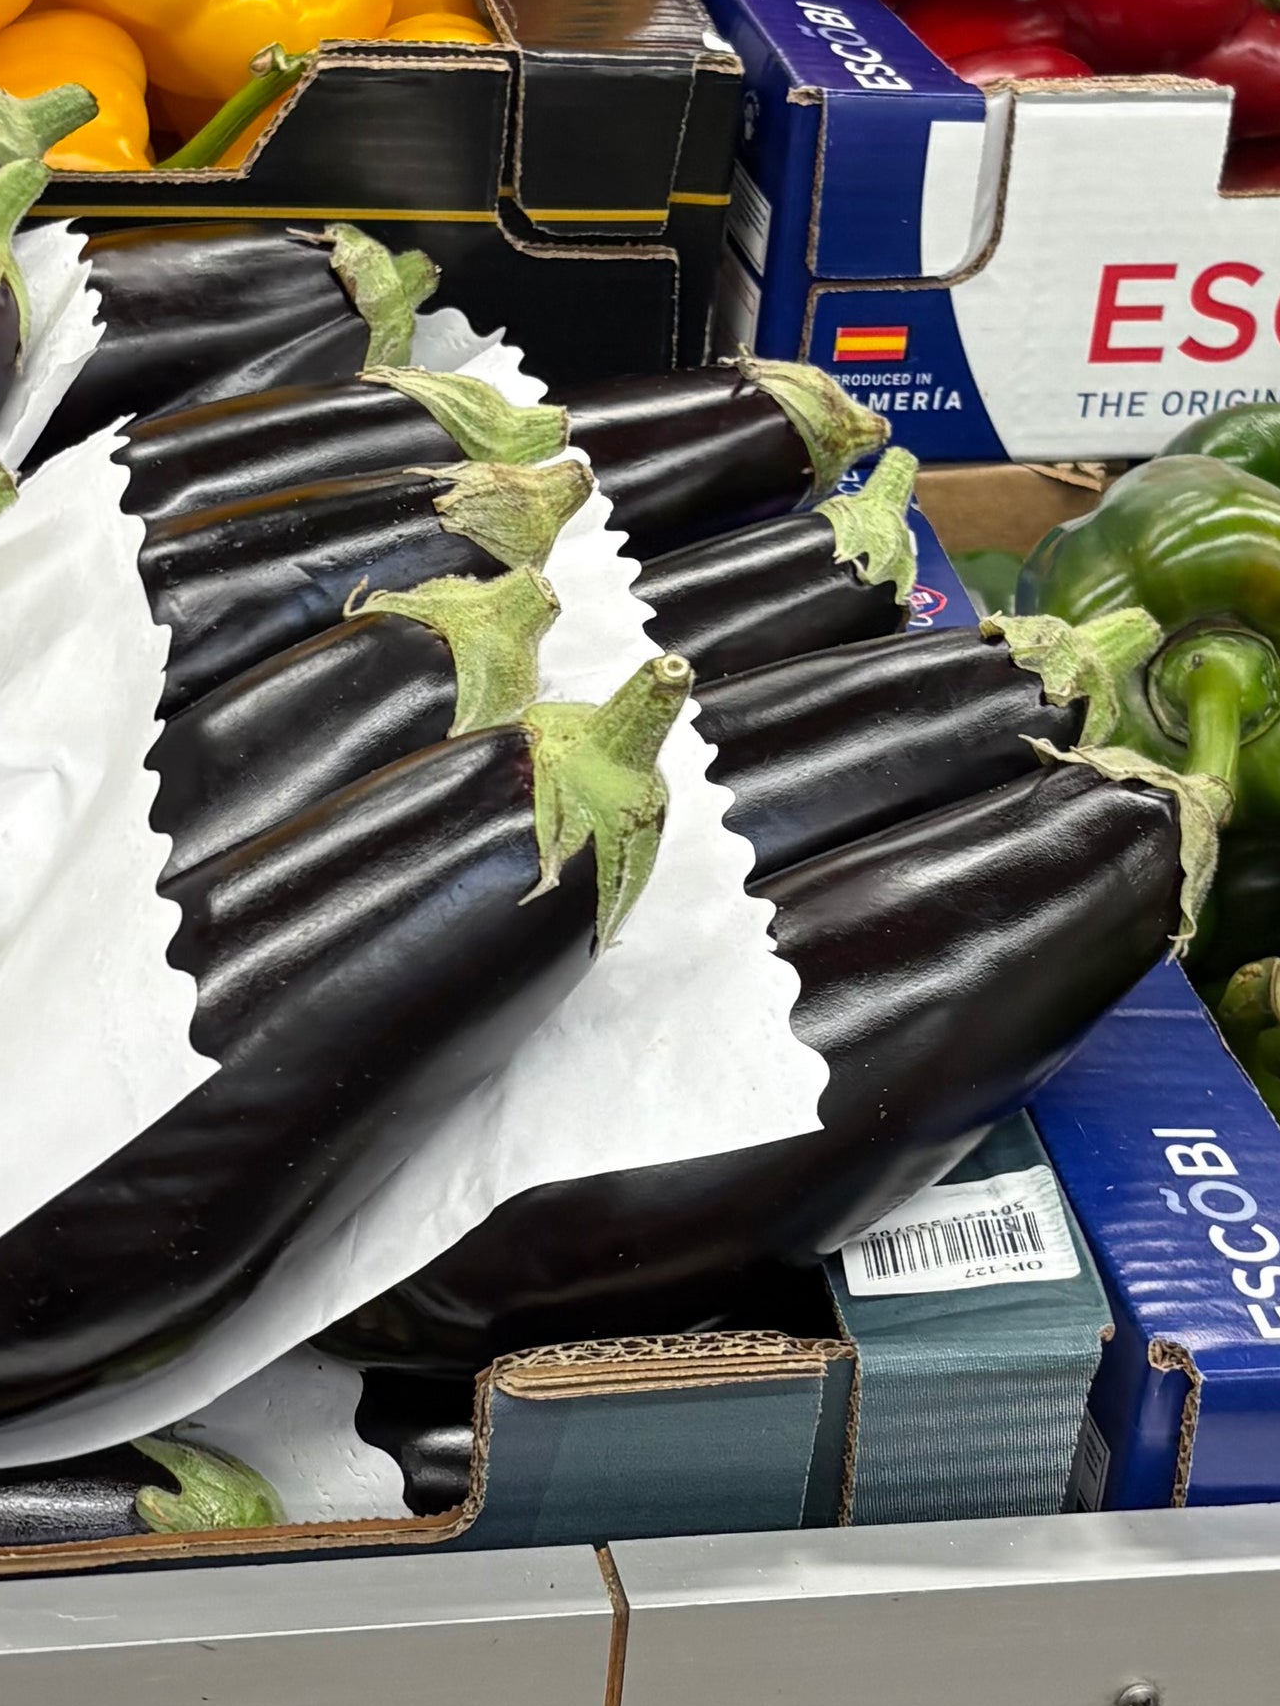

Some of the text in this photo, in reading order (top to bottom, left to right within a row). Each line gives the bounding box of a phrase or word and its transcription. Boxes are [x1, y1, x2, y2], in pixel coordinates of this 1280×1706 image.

[915, 372, 933, 385] IN
[852, 386, 963, 412] MERÍA
[1076, 391, 1148, 419] THE
[964, 1266, 996, 1279] 127
